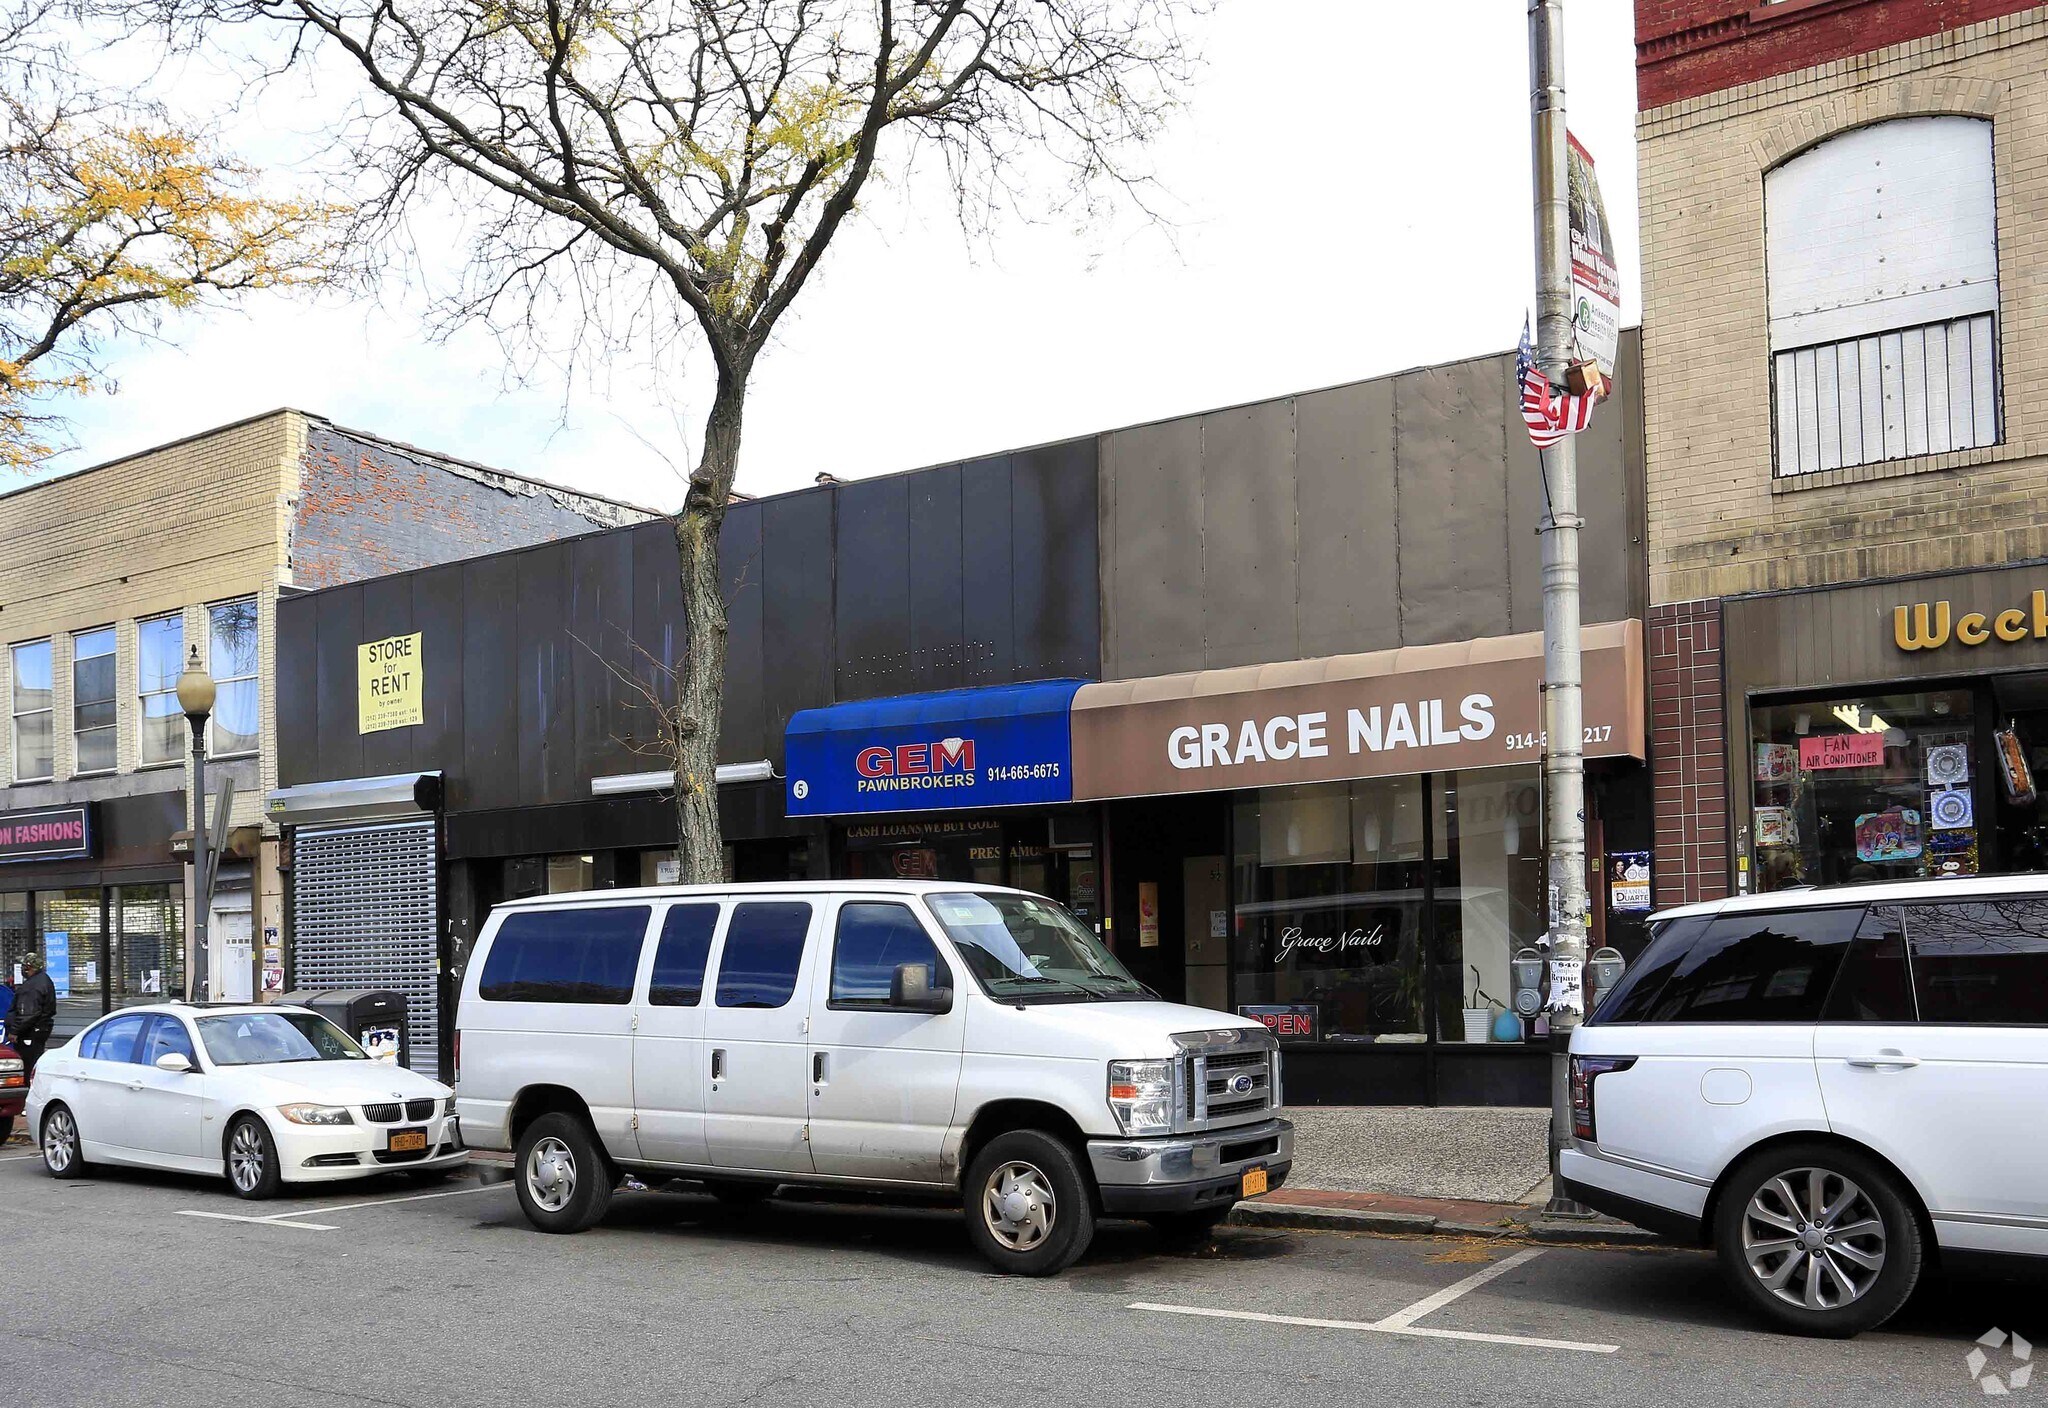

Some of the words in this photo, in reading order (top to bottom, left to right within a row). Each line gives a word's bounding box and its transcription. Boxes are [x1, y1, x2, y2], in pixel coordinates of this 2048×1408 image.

[368, 638, 412, 663] STORE
[384, 662, 397, 674] for
[371, 672, 410, 697] RENT
[386, 698, 403, 706] owner
[1167, 711, 1329, 770] GRACE
[1347, 693, 1496, 755] NAILS
[1824, 736, 1850, 752] FAN
[856, 739, 975, 778] GEM
[1806, 755, 1821, 768] AIR
[1823, 751, 1878, 766] CONDITIONER
[988, 763, 1060, 782] 914-665-6675
[797, 783, 804, 796] 5
[858, 773, 975, 792] PAWNBROKERS
[15, 820, 82, 844] FASHIONS
[847, 825, 880, 838] CASH
[882, 823, 922, 837] LOANS
[923, 822, 941, 833] WE
[1616, 892, 1649, 902] DUARTE
[1274, 926, 1333, 963] Grace
[1319, 924, 1383, 952] Nails
[1551, 973, 1578, 983] Repair
